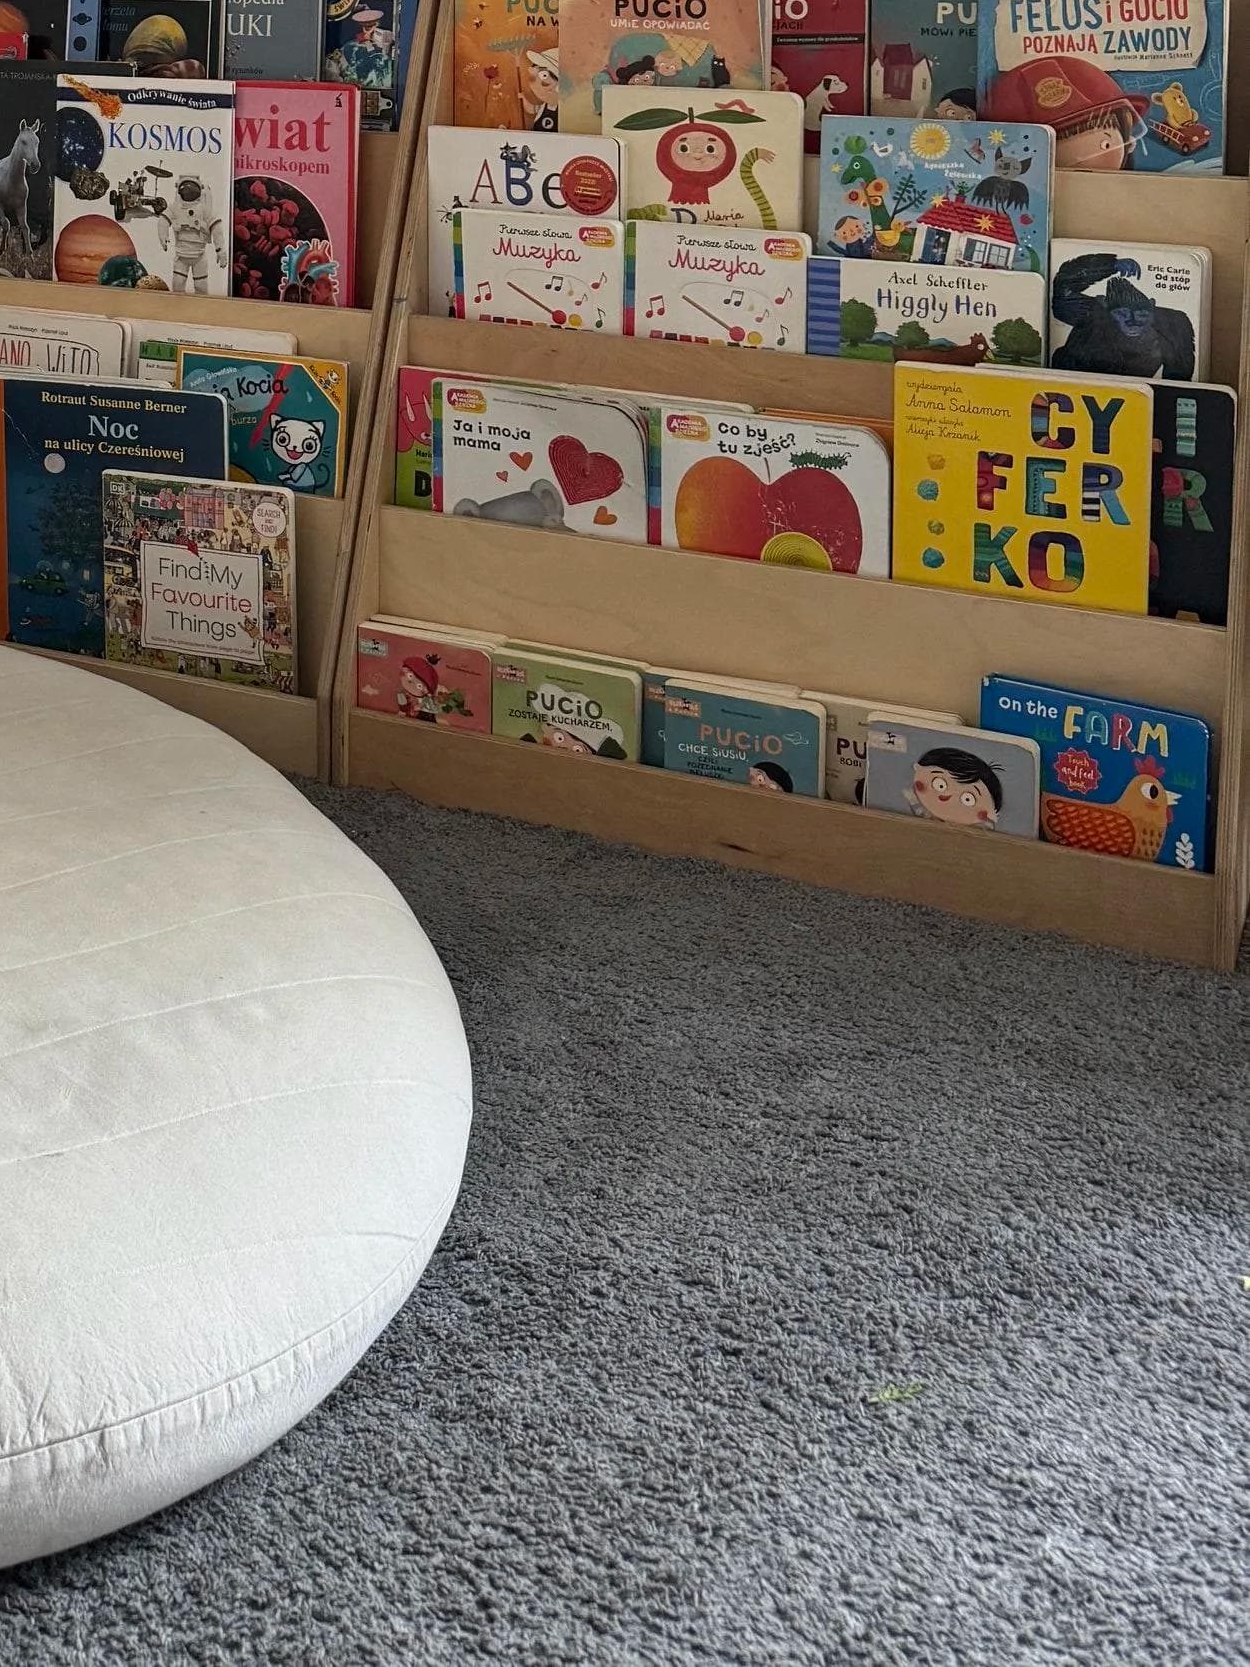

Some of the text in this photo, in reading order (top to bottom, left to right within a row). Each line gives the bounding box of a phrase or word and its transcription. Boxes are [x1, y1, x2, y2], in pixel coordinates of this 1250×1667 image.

[526, 16, 546, 27] NA
[1105, 0, 1112, 24] i
[1023, 26, 1192, 55] POZNAJĄ ZAWODY
[127, 88, 217, 109] Odkrywanie świata
[108, 122, 223, 154] KOSMOS
[498, 224, 540, 238] Pierwsze
[542, 228, 573, 239] słowa
[492, 237, 582, 269] Muzyka
[677, 234, 721, 249] Pierwsze
[724, 237, 757, 252] słowa
[668, 248, 766, 282] Muzyka
[1147, 264, 1191, 275] Eric Carle
[888, 271, 989, 292] Axel Scheffler
[1155, 274, 1191, 284] Od stóp
[1155, 282, 1191, 292] do głów
[877, 288, 997, 323] Higgly Hen
[236, 376, 290, 399] Kocia
[41, 391, 187, 414] Rotraut Susanne Berner
[906, 393, 1012, 418] Anna Salamon
[88, 414, 139, 440] Noc
[453, 419, 531, 440] Ja i moja
[718, 422, 740, 436] Co
[746, 424, 768, 442] by
[44, 438, 185, 463] na ulicy Czereśniowej
[453, 436, 501, 452] mama
[717, 440, 738, 454] tu
[742, 433, 797, 457] zjeść?
[256, 508, 282, 519] SEARCH
[159, 557, 244, 590] Find My
[151, 585, 253, 614] Favourite
[166, 610, 237, 639] Things
[508, 708, 548, 724] ZOSTAJE
[998, 696, 1170, 758] on the FARM
[678, 742, 709, 756] CHCE
[1067, 754, 1090, 768] Touch
[1061, 765, 1096, 781] and feel
